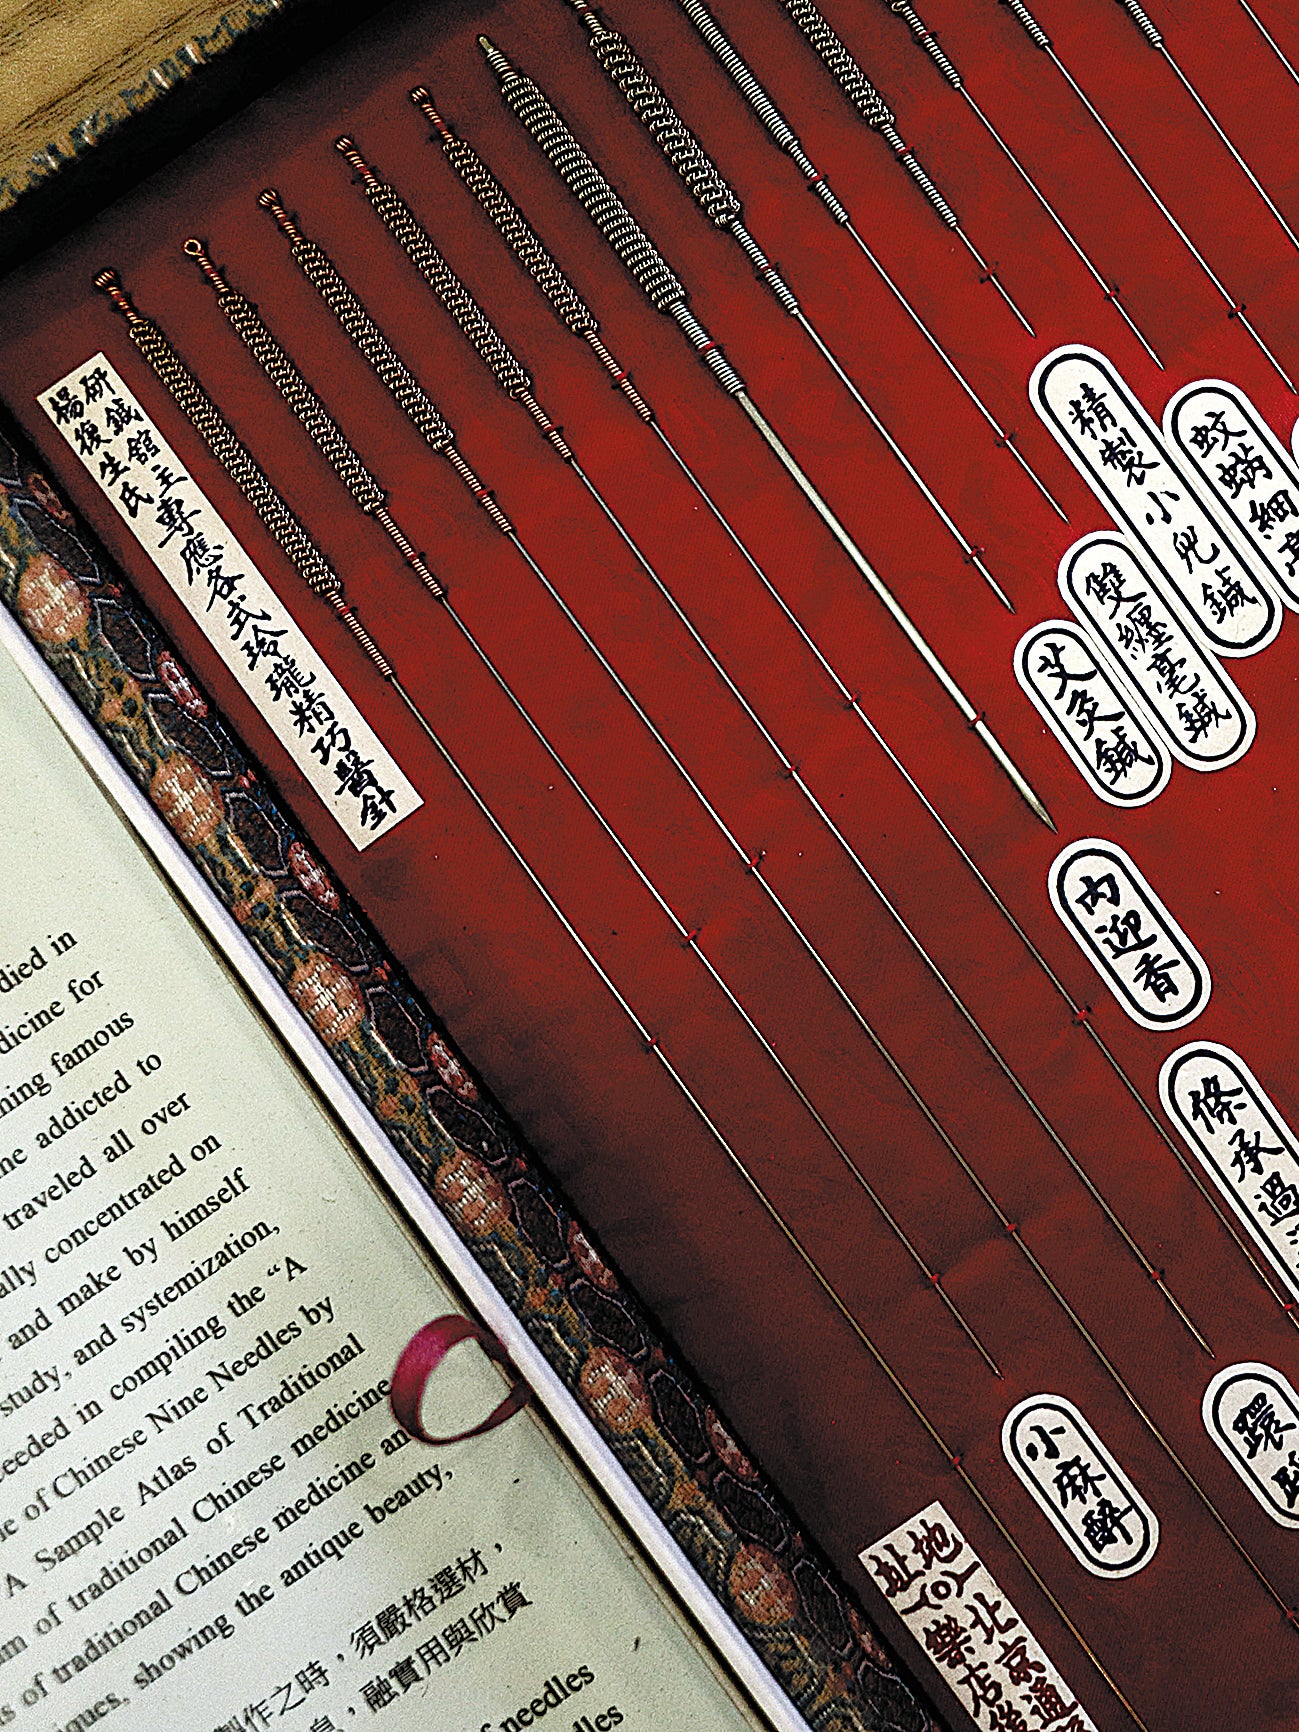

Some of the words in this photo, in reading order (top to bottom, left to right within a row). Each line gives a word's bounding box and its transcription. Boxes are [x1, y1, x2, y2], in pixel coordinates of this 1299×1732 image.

[47, 932, 78, 956] in
[68, 971, 104, 1004] for
[35, 1070, 132, 1149] addicted
[136, 1055, 161, 1076] to
[51, 1012, 134, 1077] famous
[2, 1155, 98, 1230] traveled
[102, 1129, 135, 1162] all
[141, 1093, 191, 1135] over
[45, 1153, 187, 1263] concentrated
[191, 1135, 222, 1161] on
[8, 1307, 53, 1350] and
[57, 1266, 121, 1316] make
[122, 1237, 157, 1266] by
[160, 1167, 250, 1242] himself
[74, 1323, 117, 1366] and
[121, 1222, 280, 1333] systemization,
[25, 1487, 51, 1521] of
[52, 1429, 148, 1499] Chinese
[145, 1387, 208, 1434] Nine
[205, 1321, 302, 1392] Needles
[298, 1296, 333, 1325] by
[76, 1400, 103, 1425] in
[110, 1315, 227, 1400] compiling
[227, 1287, 265, 1318] the
[6, 1573, 28, 1598] A
[34, 1507, 125, 1572] Sample
[138, 1456, 197, 1506] Atlas
[206, 1422, 235, 1454] of
[237, 1333, 365, 1429] Traditional
[35, 1602, 63, 1636] of
[67, 1517, 189, 1612] traditional
[192, 1455, 285, 1523] Chinese
[290, 1380, 392, 1458] medicine
[1026, 1425, 1132, 1552] 小麻醉
[22, 1671, 49, 1707] of
[52, 1588, 174, 1684] traditional
[174, 1527, 269, 1596] Chinese
[272, 1452, 375, 1532] medicine
[134, 1614, 235, 1690] showing
[235, 1585, 274, 1617] the
[280, 1522, 364, 1588] antique
[361, 1464, 452, 1524] beauty,
[500, 1665, 595, 1732] needles
